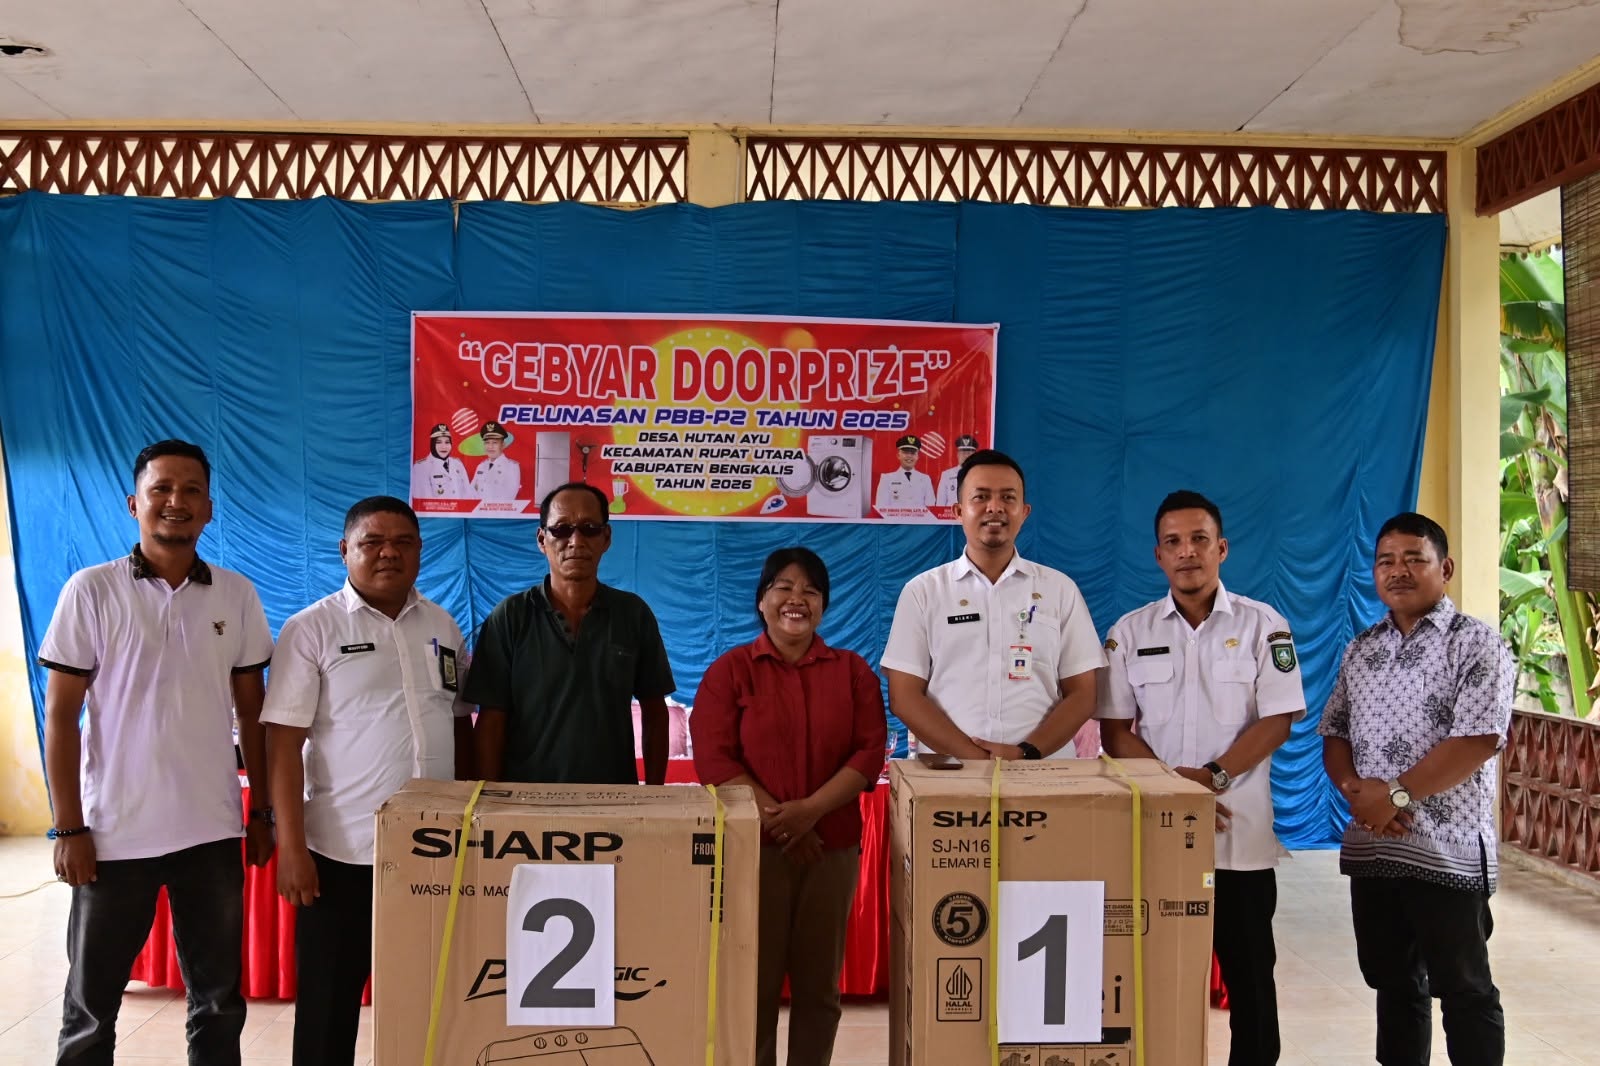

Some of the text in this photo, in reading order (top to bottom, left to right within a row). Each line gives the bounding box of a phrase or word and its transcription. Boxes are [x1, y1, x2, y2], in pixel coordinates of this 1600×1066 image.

[499, 406, 909, 429] PELUNASAN PBB-P2 TAHUN 2025
[638, 432, 770, 444] DESA HUTAN AYU
[602, 447, 804, 460] KECAMATAN RUPAT UTARA
[613, 462, 794, 475] KABUPATEN BENGKALIS
[655, 478, 752, 489] TAHUN 2026
[933, 811, 1048, 828] SHARP
[411, 827, 624, 862] SHARP
[694, 843, 716, 855] FRON
[932, 839, 992, 853] SJ-N16
[931, 857, 980, 869] LEMARI
[411, 884, 510, 897] WASHNG MAC
[1188, 903, 1207, 914] HS
[946, 906, 973, 938] 5
[520, 898, 596, 1008] 2
[1018, 915, 1068, 1025] 1
